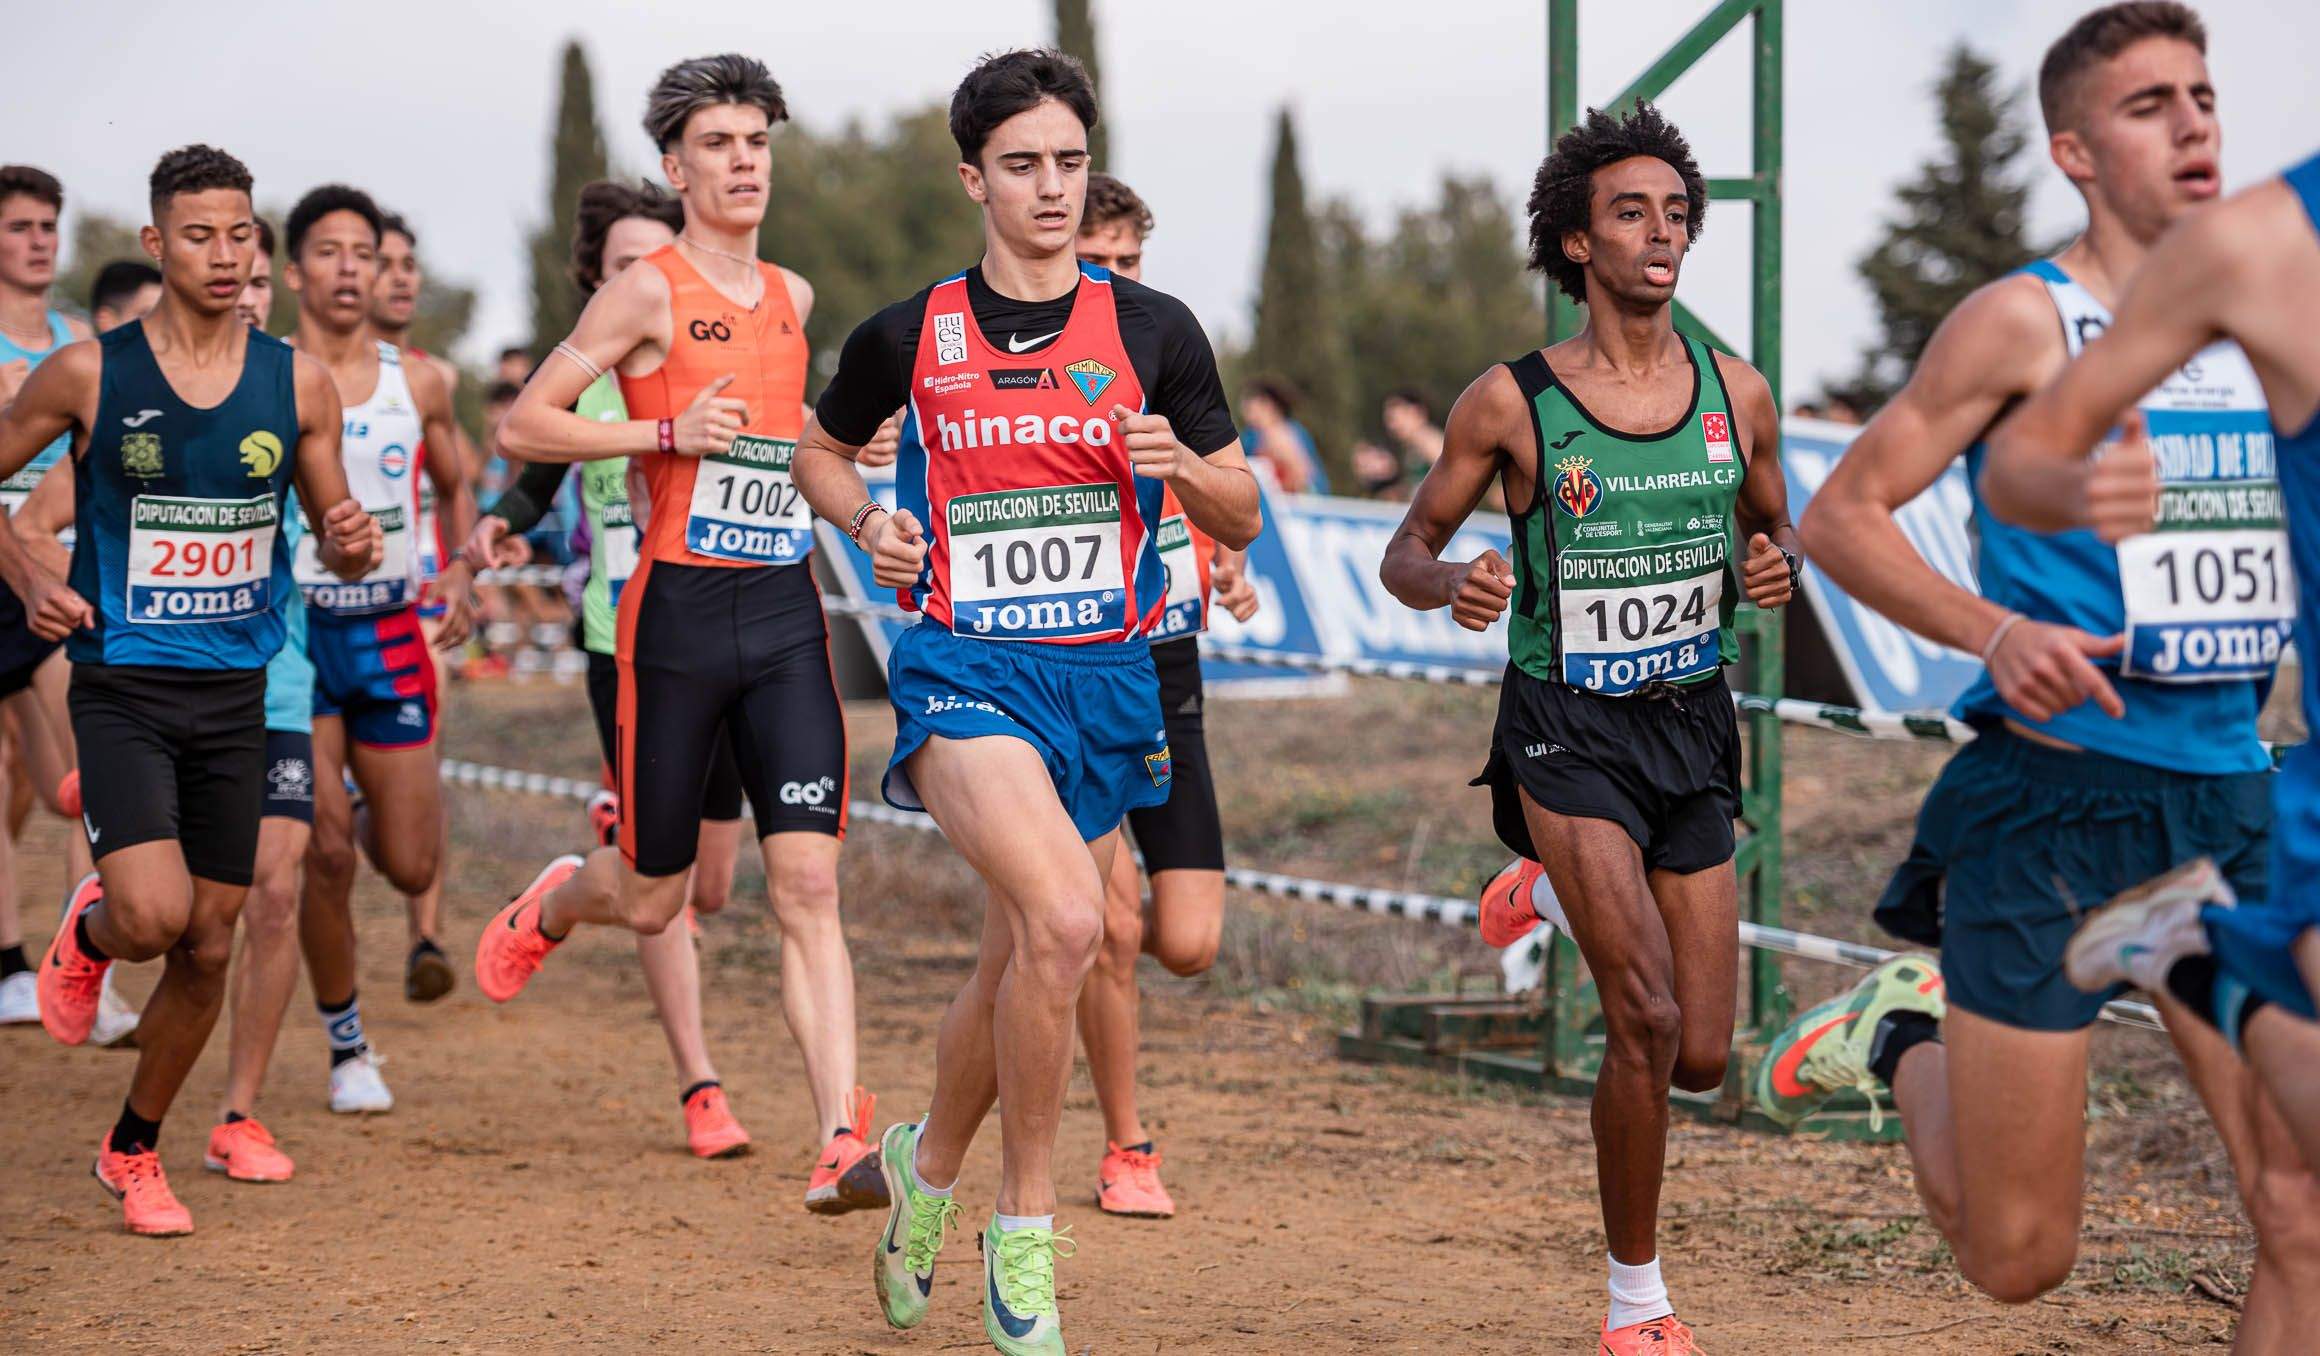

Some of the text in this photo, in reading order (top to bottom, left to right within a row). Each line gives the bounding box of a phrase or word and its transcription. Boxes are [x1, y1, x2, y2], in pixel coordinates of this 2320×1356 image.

[690, 320, 731, 342] GO
[934, 373, 979, 385] Hidro-Nitro
[935, 381, 972, 394] Española
[997, 375, 1037, 385] ARAGÓN
[937, 409, 1112, 453] hinaco
[728, 438, 776, 464] UTACION
[717, 475, 799, 519] 1002
[1605, 470, 1711, 493] VILLARREAL
[136, 502, 217, 525] DIPUTACION
[219, 506, 237, 526] DE
[238, 500, 277, 525] SEVILLA
[952, 490, 1119, 526] DIPUTACION DE SEVILLA
[699, 522, 794, 557] Joma
[1582, 524, 1618, 533] COMUNITAT
[150, 537, 254, 578] 2901
[973, 534, 1102, 588] 1007
[1564, 542, 1724, 581] DIPUTACION DE SEVILLA
[2155, 547, 2278, 605] 1051
[144, 588, 254, 618] Joma
[972, 597, 1103, 634] Joma
[1585, 586, 1706, 642] 1024
[1585, 641, 1700, 690] Joma
[779, 781, 826, 805] GO
